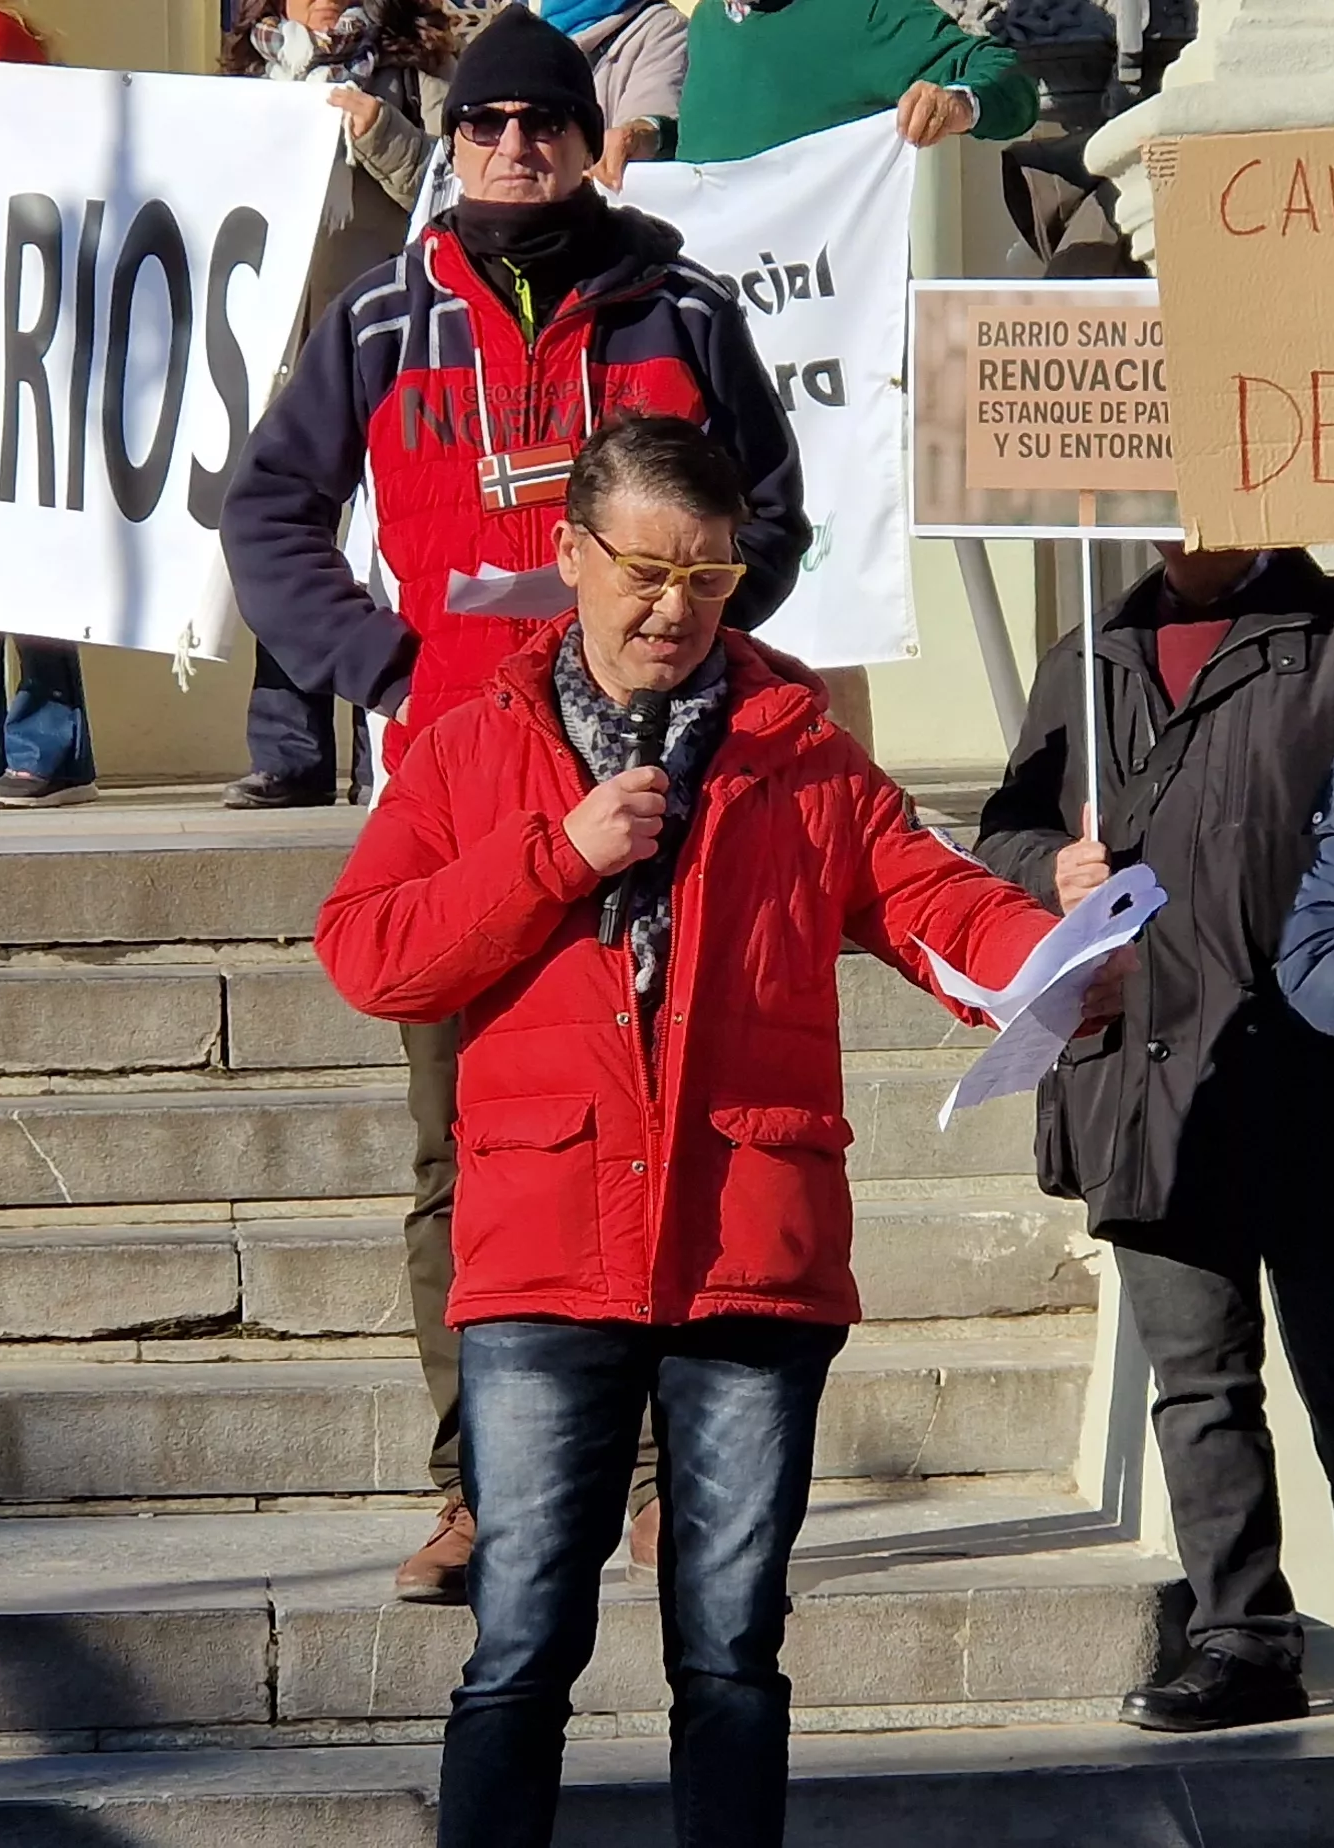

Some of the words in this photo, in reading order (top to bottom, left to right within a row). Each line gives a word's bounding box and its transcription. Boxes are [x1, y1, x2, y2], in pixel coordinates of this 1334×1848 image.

[976, 320, 1070, 348] BARRIO
[1076, 320, 1128, 348] SAN
[1133, 320, 1164, 348] JO
[978, 400, 1094, 426] ESTANQUE
[1099, 400, 1128, 425] DE
[992, 432, 1011, 458] Y
[1017, 431, 1051, 459] SU
